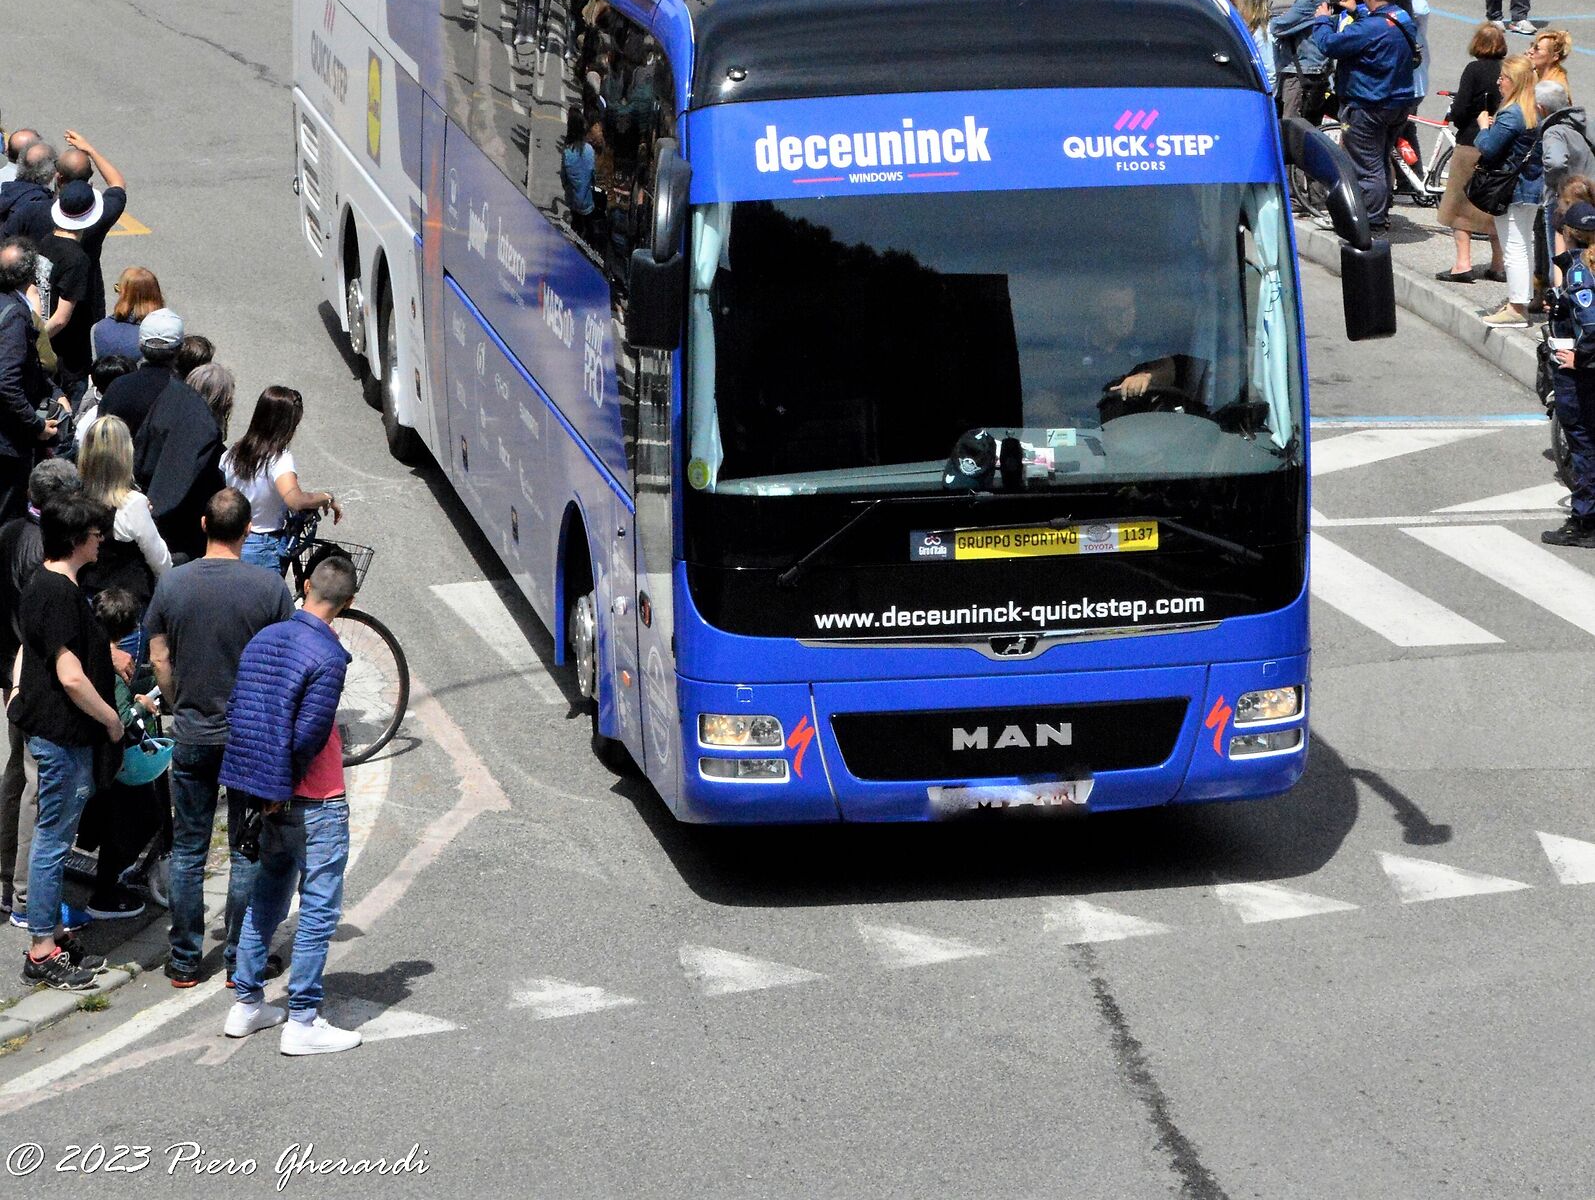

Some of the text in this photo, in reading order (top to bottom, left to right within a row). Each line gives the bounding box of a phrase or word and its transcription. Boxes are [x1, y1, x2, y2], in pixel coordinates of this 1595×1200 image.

[754, 115, 992, 174] deceuninck
[1116, 161, 1166, 172] FLOORS
[848, 171, 904, 184] WINDOWS
[958, 530, 1077, 550] GRUPPO SPORTIVO
[1123, 528, 1153, 542] 1137
[1084, 543, 1114, 551] TOYOTA
[814, 596, 1205, 629] www.deceuninck-quickstep.com
[952, 722, 1073, 752] MAN
